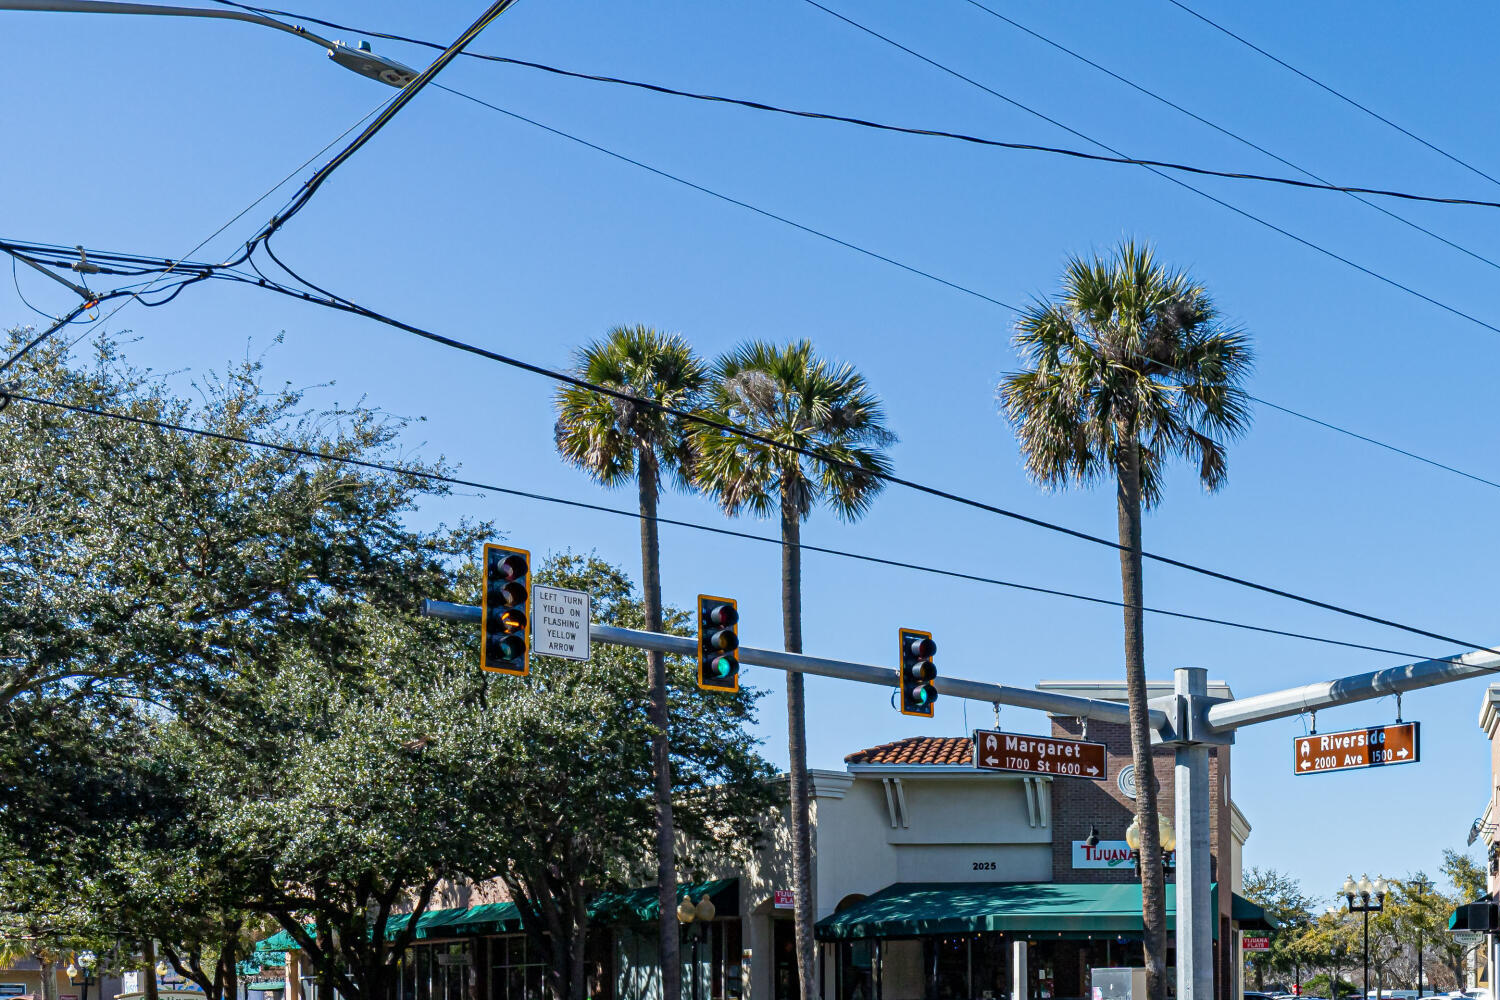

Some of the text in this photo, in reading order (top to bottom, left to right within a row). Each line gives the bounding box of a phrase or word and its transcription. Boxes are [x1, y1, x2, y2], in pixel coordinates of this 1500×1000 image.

[540, 592, 583, 606] LEFT TURN
[543, 604, 581, 617] YIELD ON
[544, 617, 580, 629] FLASHING
[547, 629, 577, 640] YELLOW
[549, 642, 575, 652] ARROW
[1005, 736, 1081, 758] Margaret
[1321, 731, 1386, 751] Riverside
[1315, 749, 1393, 769] 2000 Ave 1500
[1006, 757, 1080, 775] 1700 St 1600
[972, 862, 997, 871] 2025
